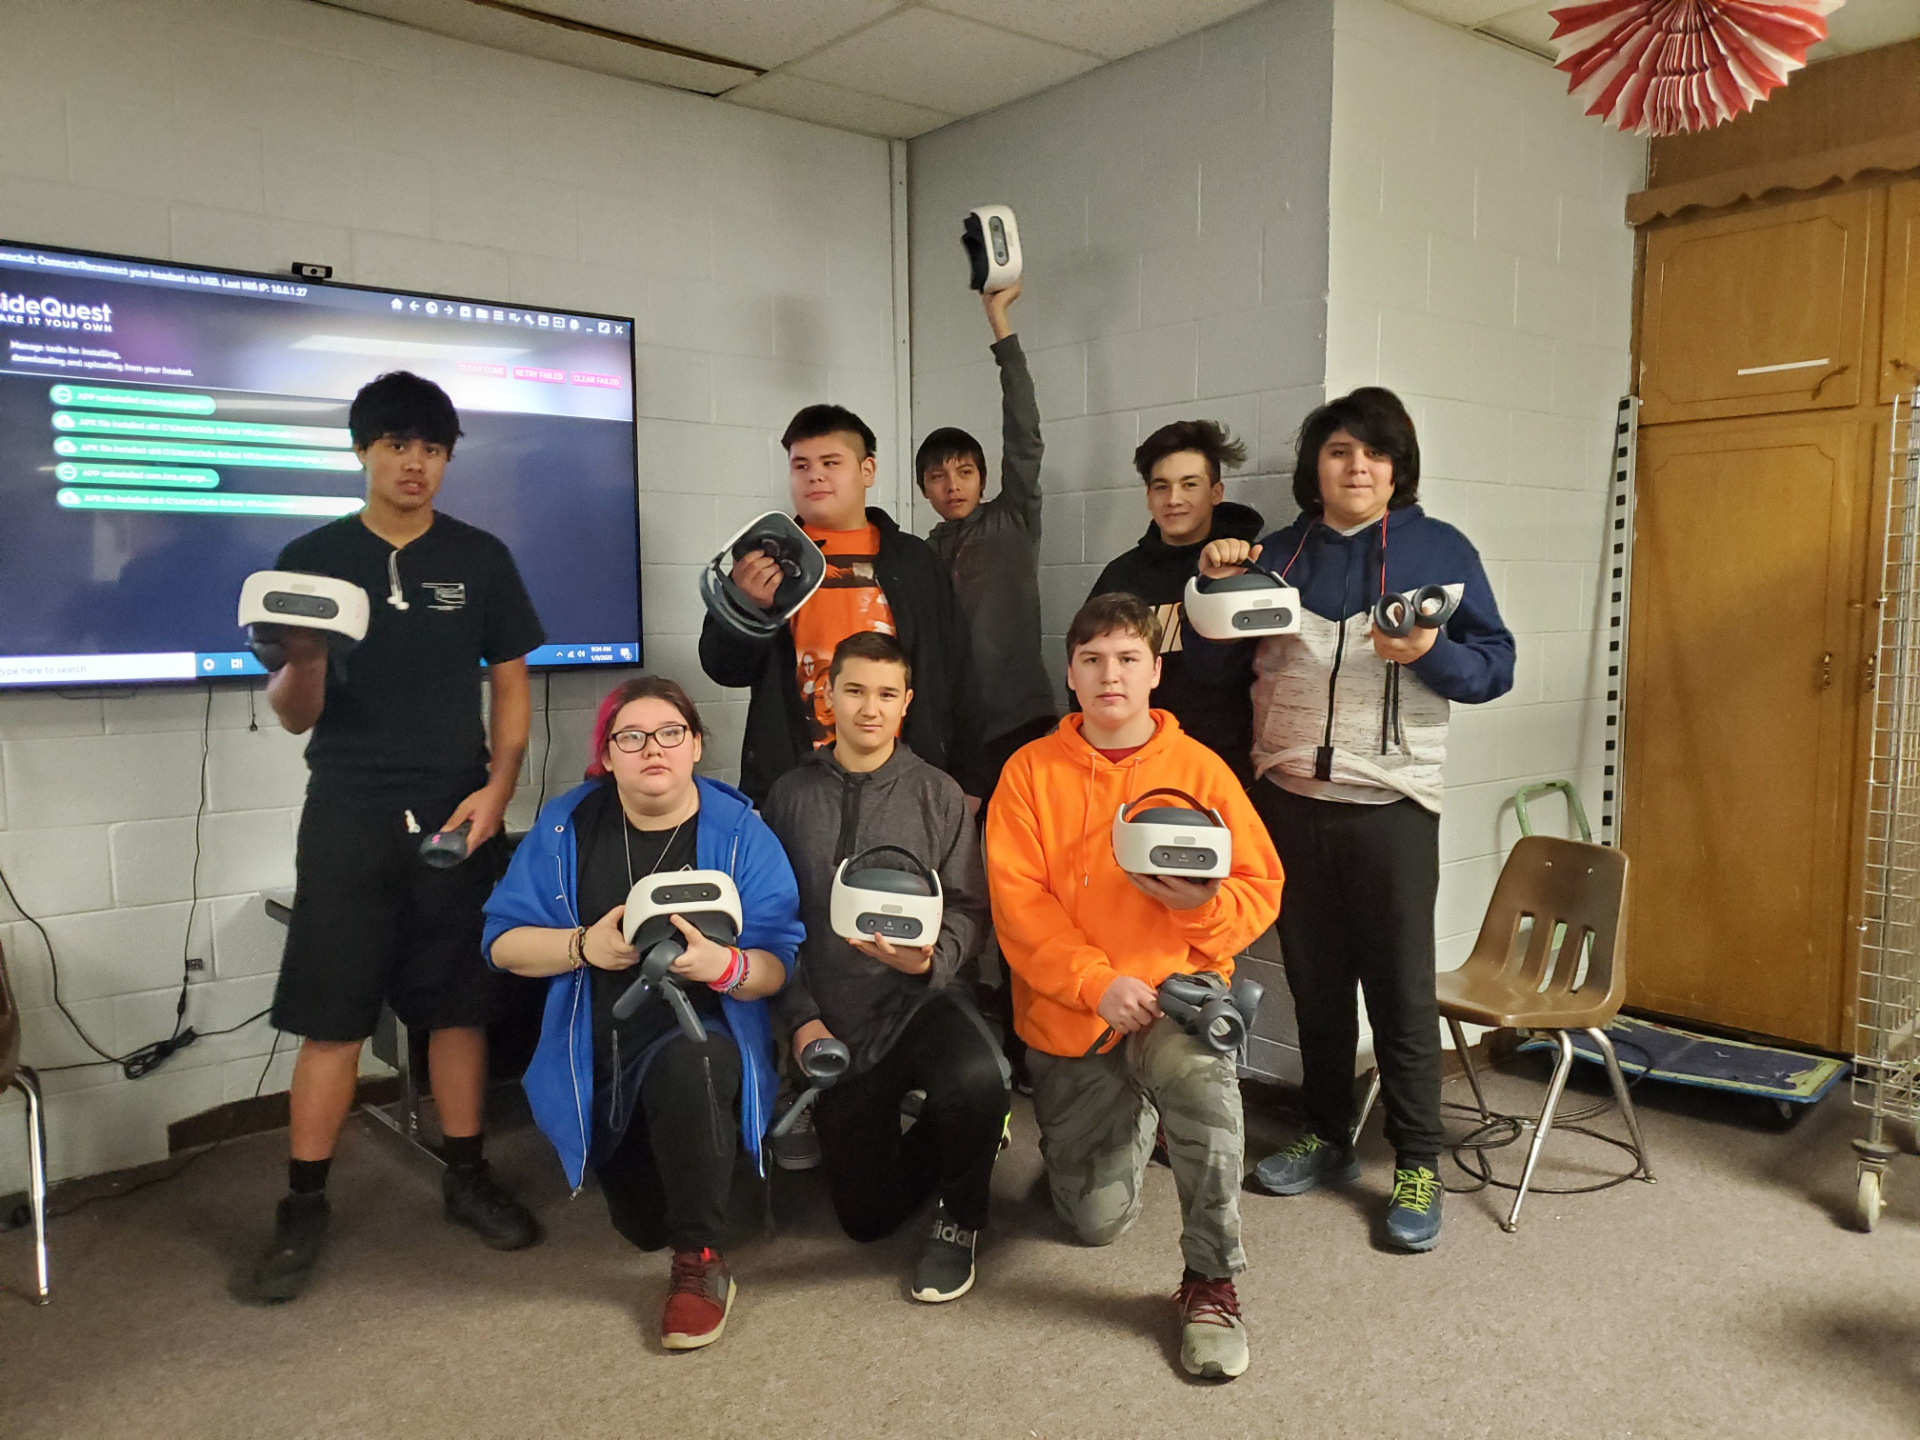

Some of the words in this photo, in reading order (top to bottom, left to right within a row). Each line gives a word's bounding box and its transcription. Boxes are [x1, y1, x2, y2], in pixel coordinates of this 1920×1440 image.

[129, 268, 150, 278] your
[187, 274, 200, 284] via
[0, 292, 112, 322] ideQuest
[0, 314, 24, 324] AKE
[28, 316, 41, 325] IT
[45, 318, 78, 330] YOUR
[83, 322, 112, 332] OWN
[68, 346, 80, 355] for
[11, 353, 66, 367] downloading
[67, 359, 82, 367] and
[84, 361, 123, 372] uploading
[124, 363, 143, 373] from
[144, 366, 161, 374] your
[458, 363, 483, 373] CLEAR
[484, 366, 505, 375] DONE
[515, 369, 538, 379] RETRY
[539, 371, 564, 381] FAILED
[573, 374, 595, 384] CLEAR
[596, 376, 619, 386] FAILED
[21, 666, 42, 675] here
[57, 665, 87, 674] search
